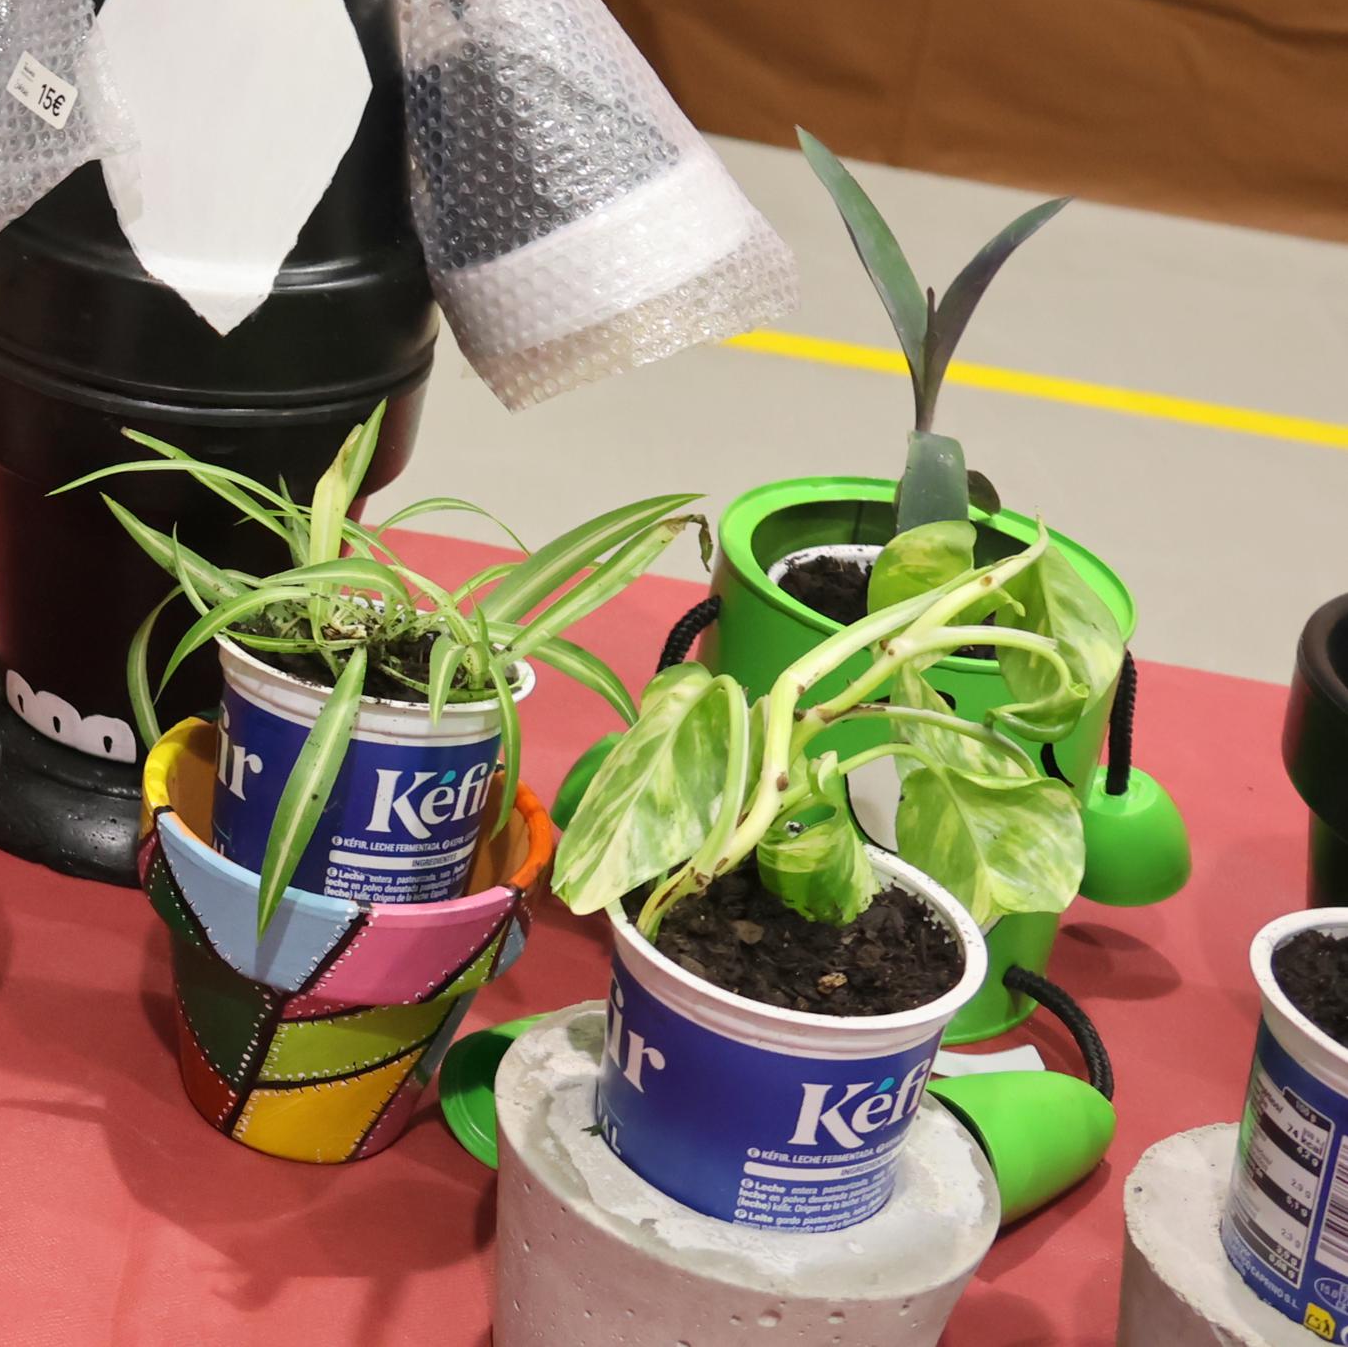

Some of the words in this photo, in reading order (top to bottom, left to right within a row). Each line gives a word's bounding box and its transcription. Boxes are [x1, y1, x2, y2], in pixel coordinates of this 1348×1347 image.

[37, 83, 66, 117] 15€
[370, 842, 395, 852] LECHE
[338, 869, 365, 882] Leche
[608, 975, 666, 1093] ir
[788, 1058, 930, 1148] Kéfi
[792, 1154, 822, 1164] LECHE
